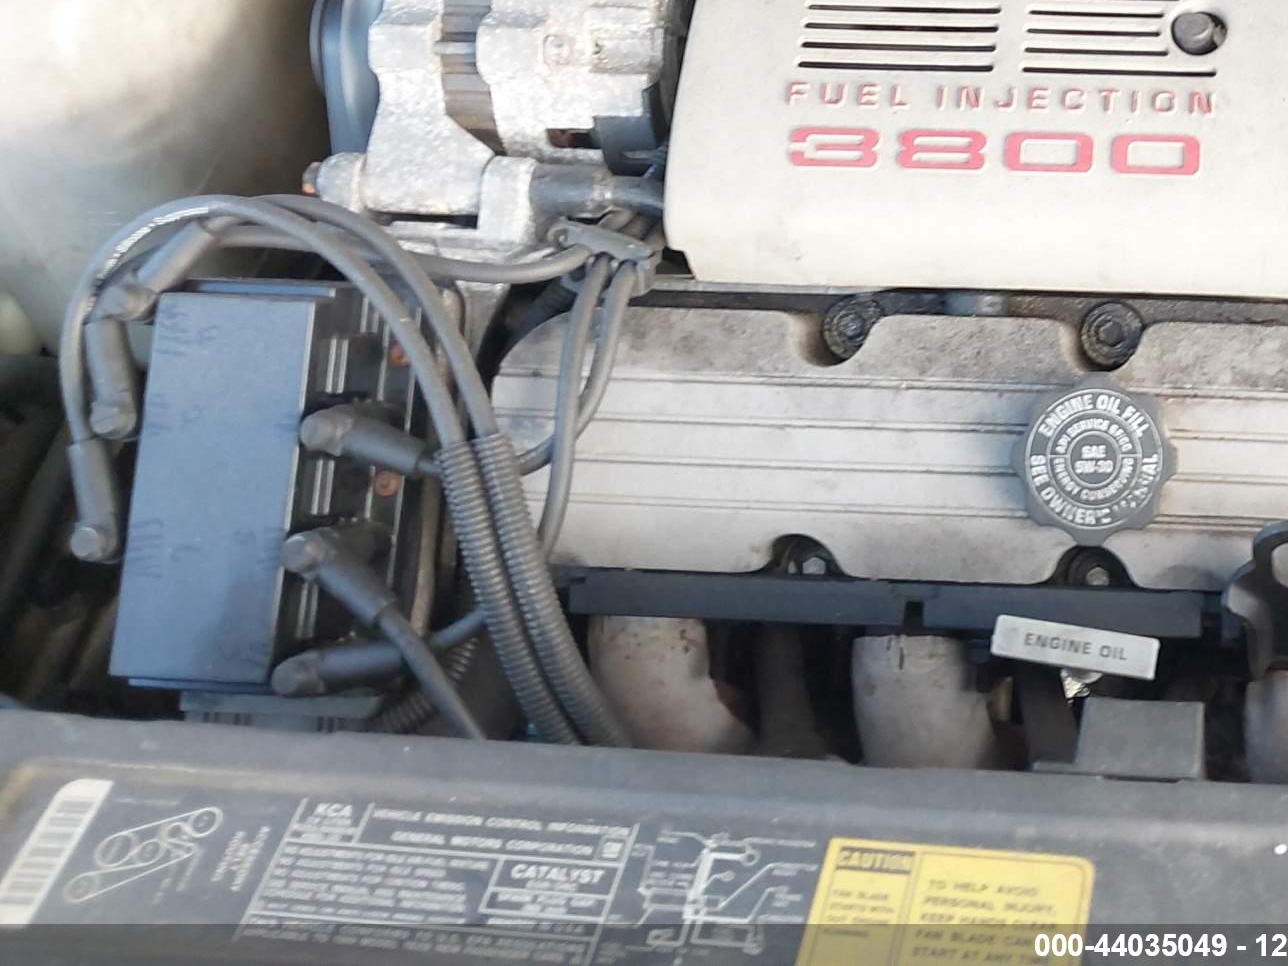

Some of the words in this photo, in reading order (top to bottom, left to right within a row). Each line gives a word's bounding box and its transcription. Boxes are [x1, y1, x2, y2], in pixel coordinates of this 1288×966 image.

[784, 81, 912, 109] FUEL
[936, 85, 1218, 117] INJECTION
[788, 125, 1203, 177] 3800
[1038, 394, 1094, 438] ENGINE
[1096, 394, 1122, 414] OIL
[1121, 405, 1150, 438] FILL
[1081, 444, 1107, 459] SAE
[1030, 454, 1050, 486] SEE
[1024, 632, 1093, 656] ENGINE
[1099, 644, 1127, 661] OIL
[510, 863, 605, 883] CATALYST
[929, 879, 947, 890] TO
[953, 882, 989, 893] HELP
[924, 896, 995, 911] PERSONAL
[920, 912, 955, 923] KEEP
